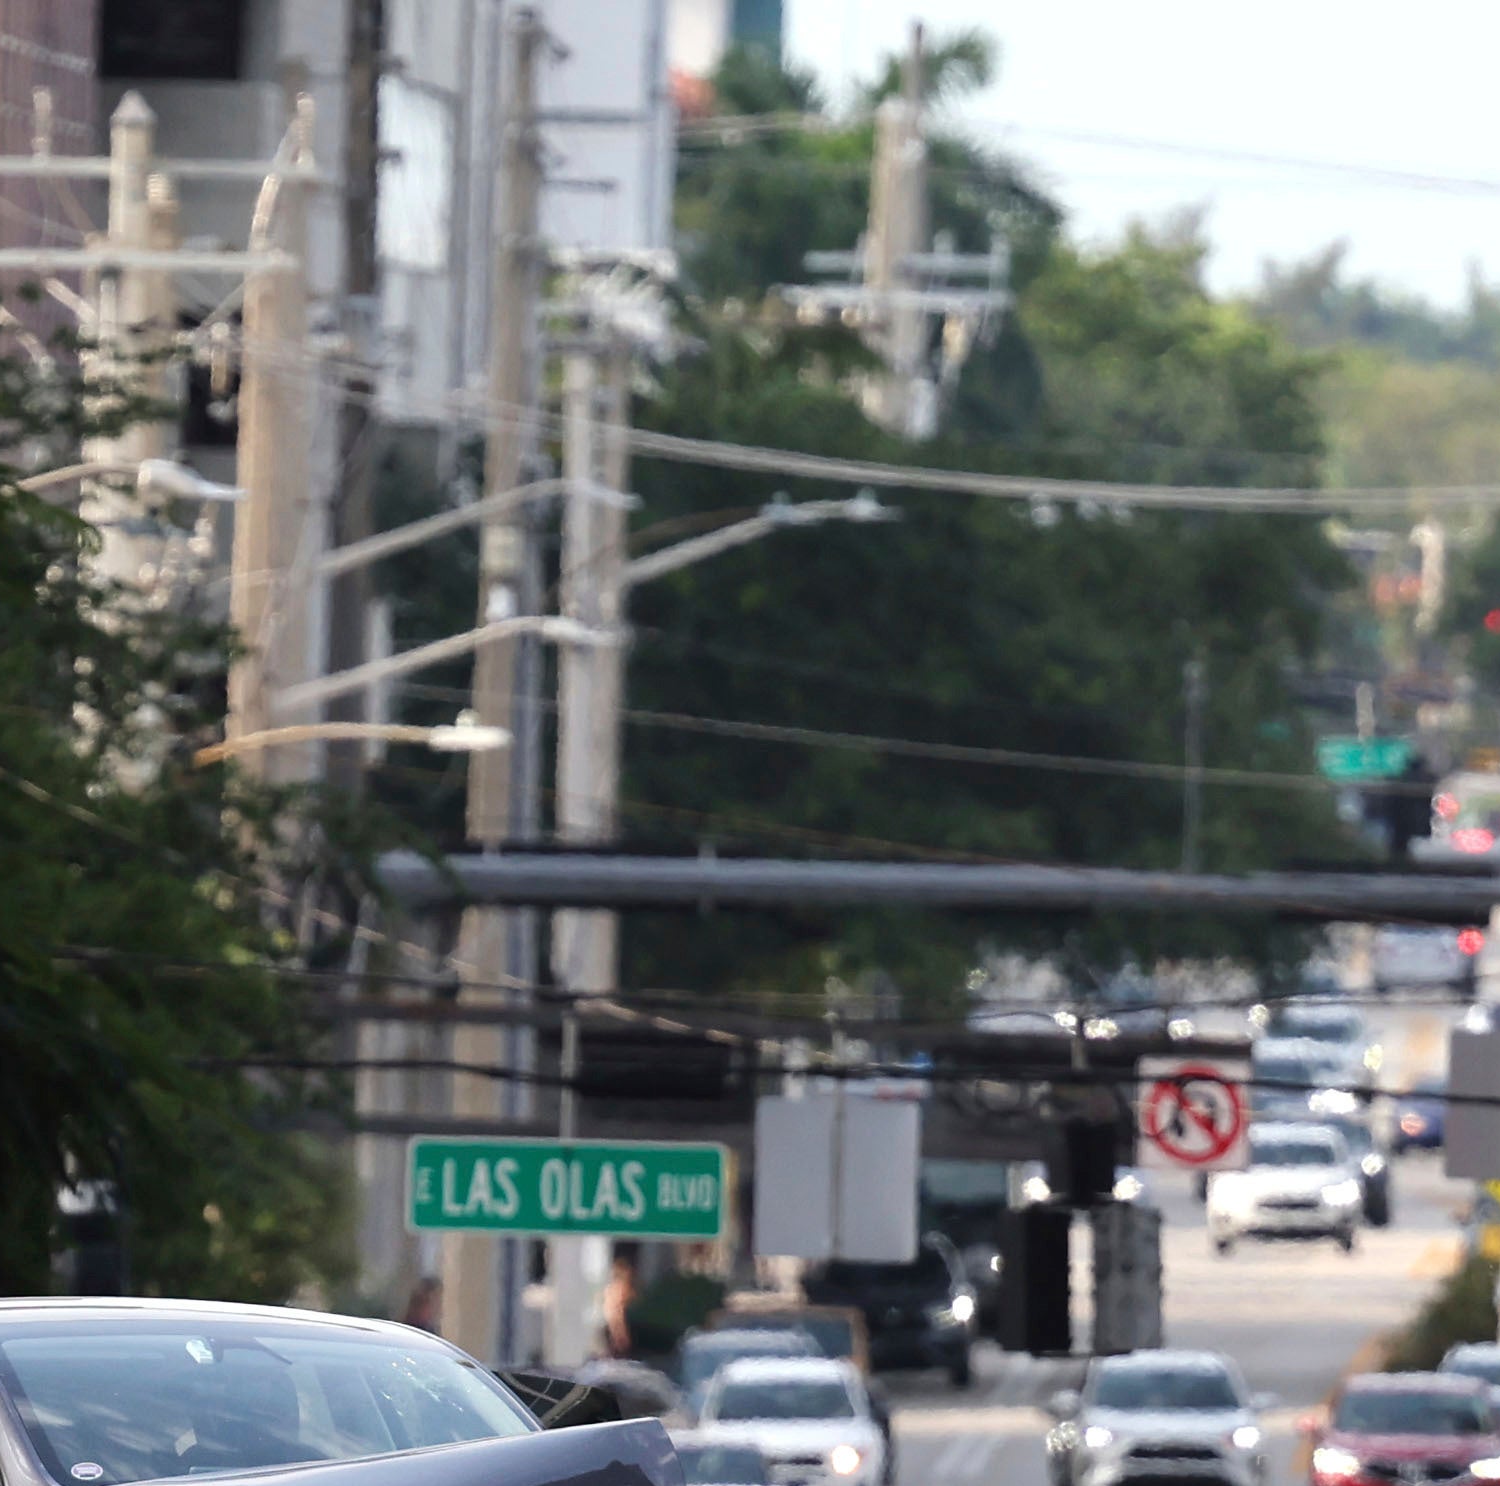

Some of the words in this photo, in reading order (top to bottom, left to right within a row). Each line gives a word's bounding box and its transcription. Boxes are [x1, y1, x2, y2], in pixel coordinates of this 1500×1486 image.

[441, 1157, 521, 1219] LAS
[538, 1158, 647, 1222] OLAS
[655, 1172, 718, 1212] BLVD
